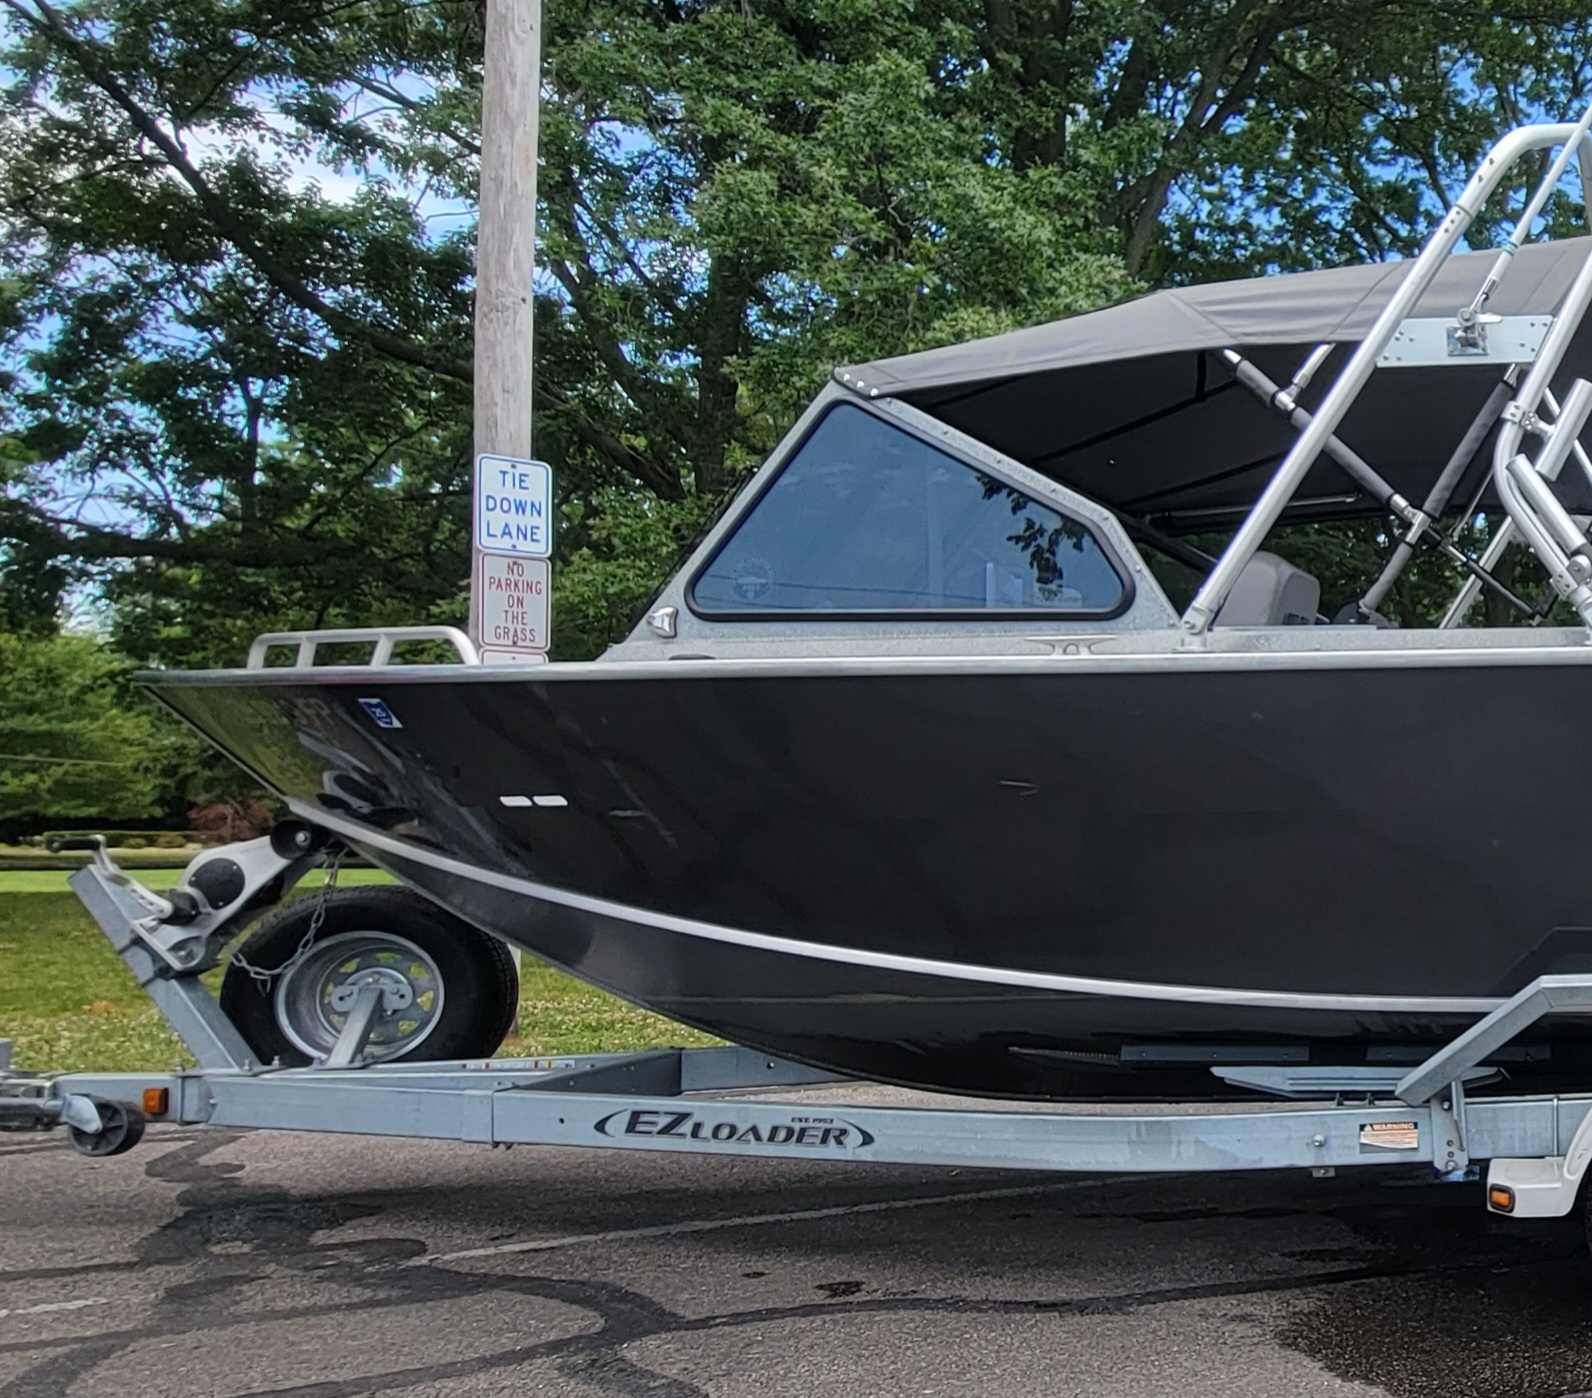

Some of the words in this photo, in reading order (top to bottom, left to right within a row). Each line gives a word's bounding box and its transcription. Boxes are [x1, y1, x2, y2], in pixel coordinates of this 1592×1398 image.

[499, 469, 530, 491] TIE
[486, 495, 543, 518] DOWN
[486, 521, 541, 543] LANE
[507, 561, 525, 577] NO
[489, 576, 542, 595] PARKING
[507, 594, 525, 609] ON
[504, 610, 528, 626] THE
[494, 625, 537, 643] GRASS
[1373, 1122, 1415, 1131] WARNING
